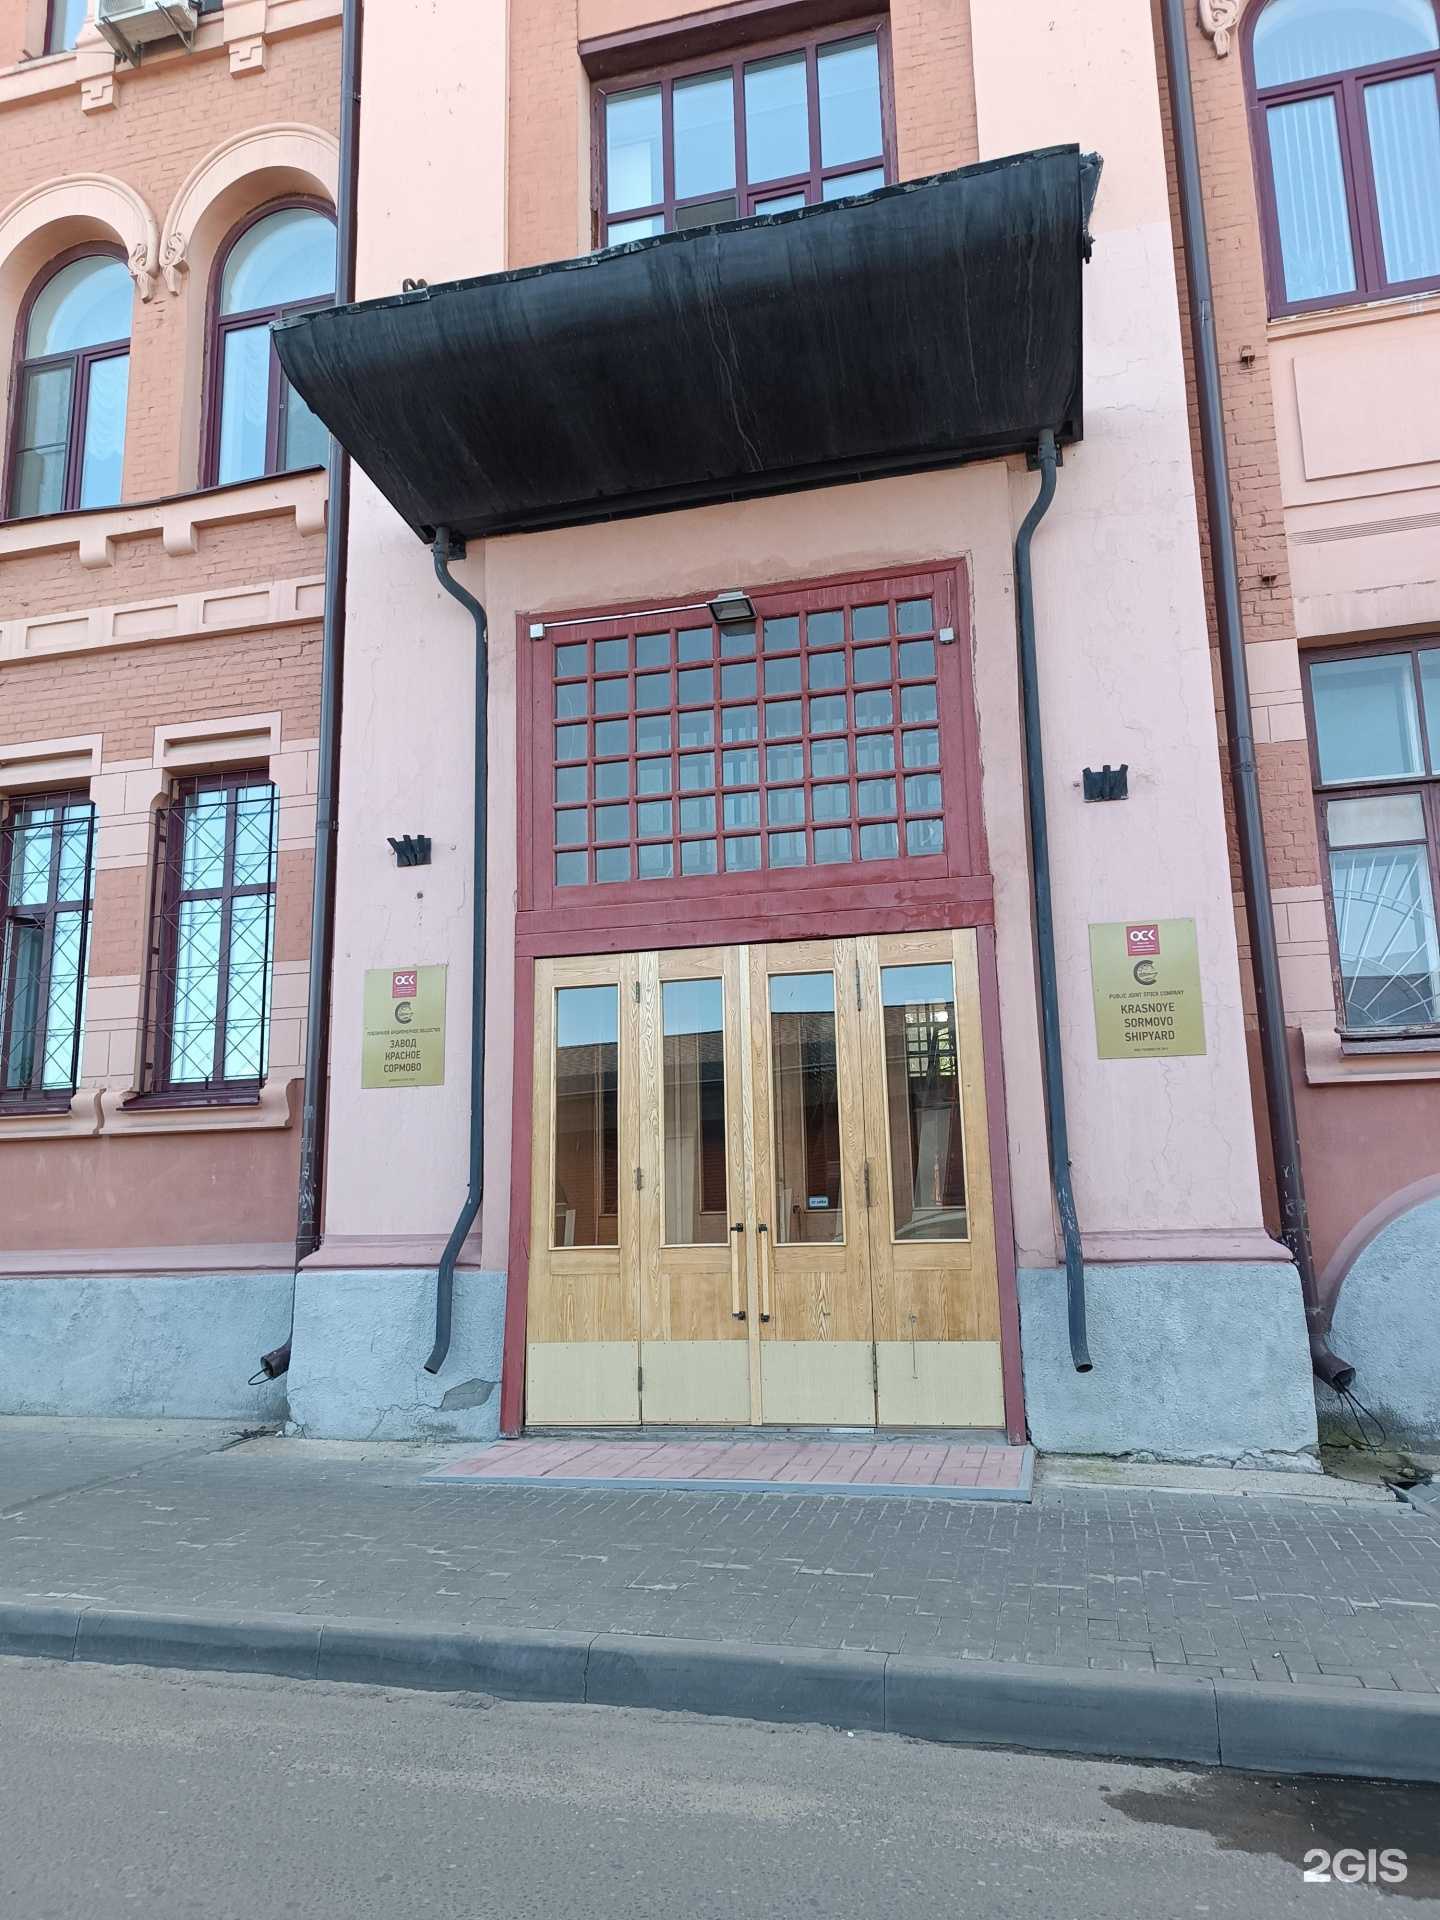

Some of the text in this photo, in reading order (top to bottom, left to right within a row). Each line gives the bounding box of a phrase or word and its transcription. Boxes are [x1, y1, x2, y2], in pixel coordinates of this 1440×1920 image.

[1120, 1002, 1175, 1014] KRASNOYE
[1124, 1016, 1174, 1028] SORMOVO
[1124, 1030, 1175, 1042] SHIPYARD
[390, 1038, 417, 1048] ЗАВОД
[385, 1050, 421, 1061] КРАСНОЕ
[383, 1062, 422, 1073] СОРМОВО
